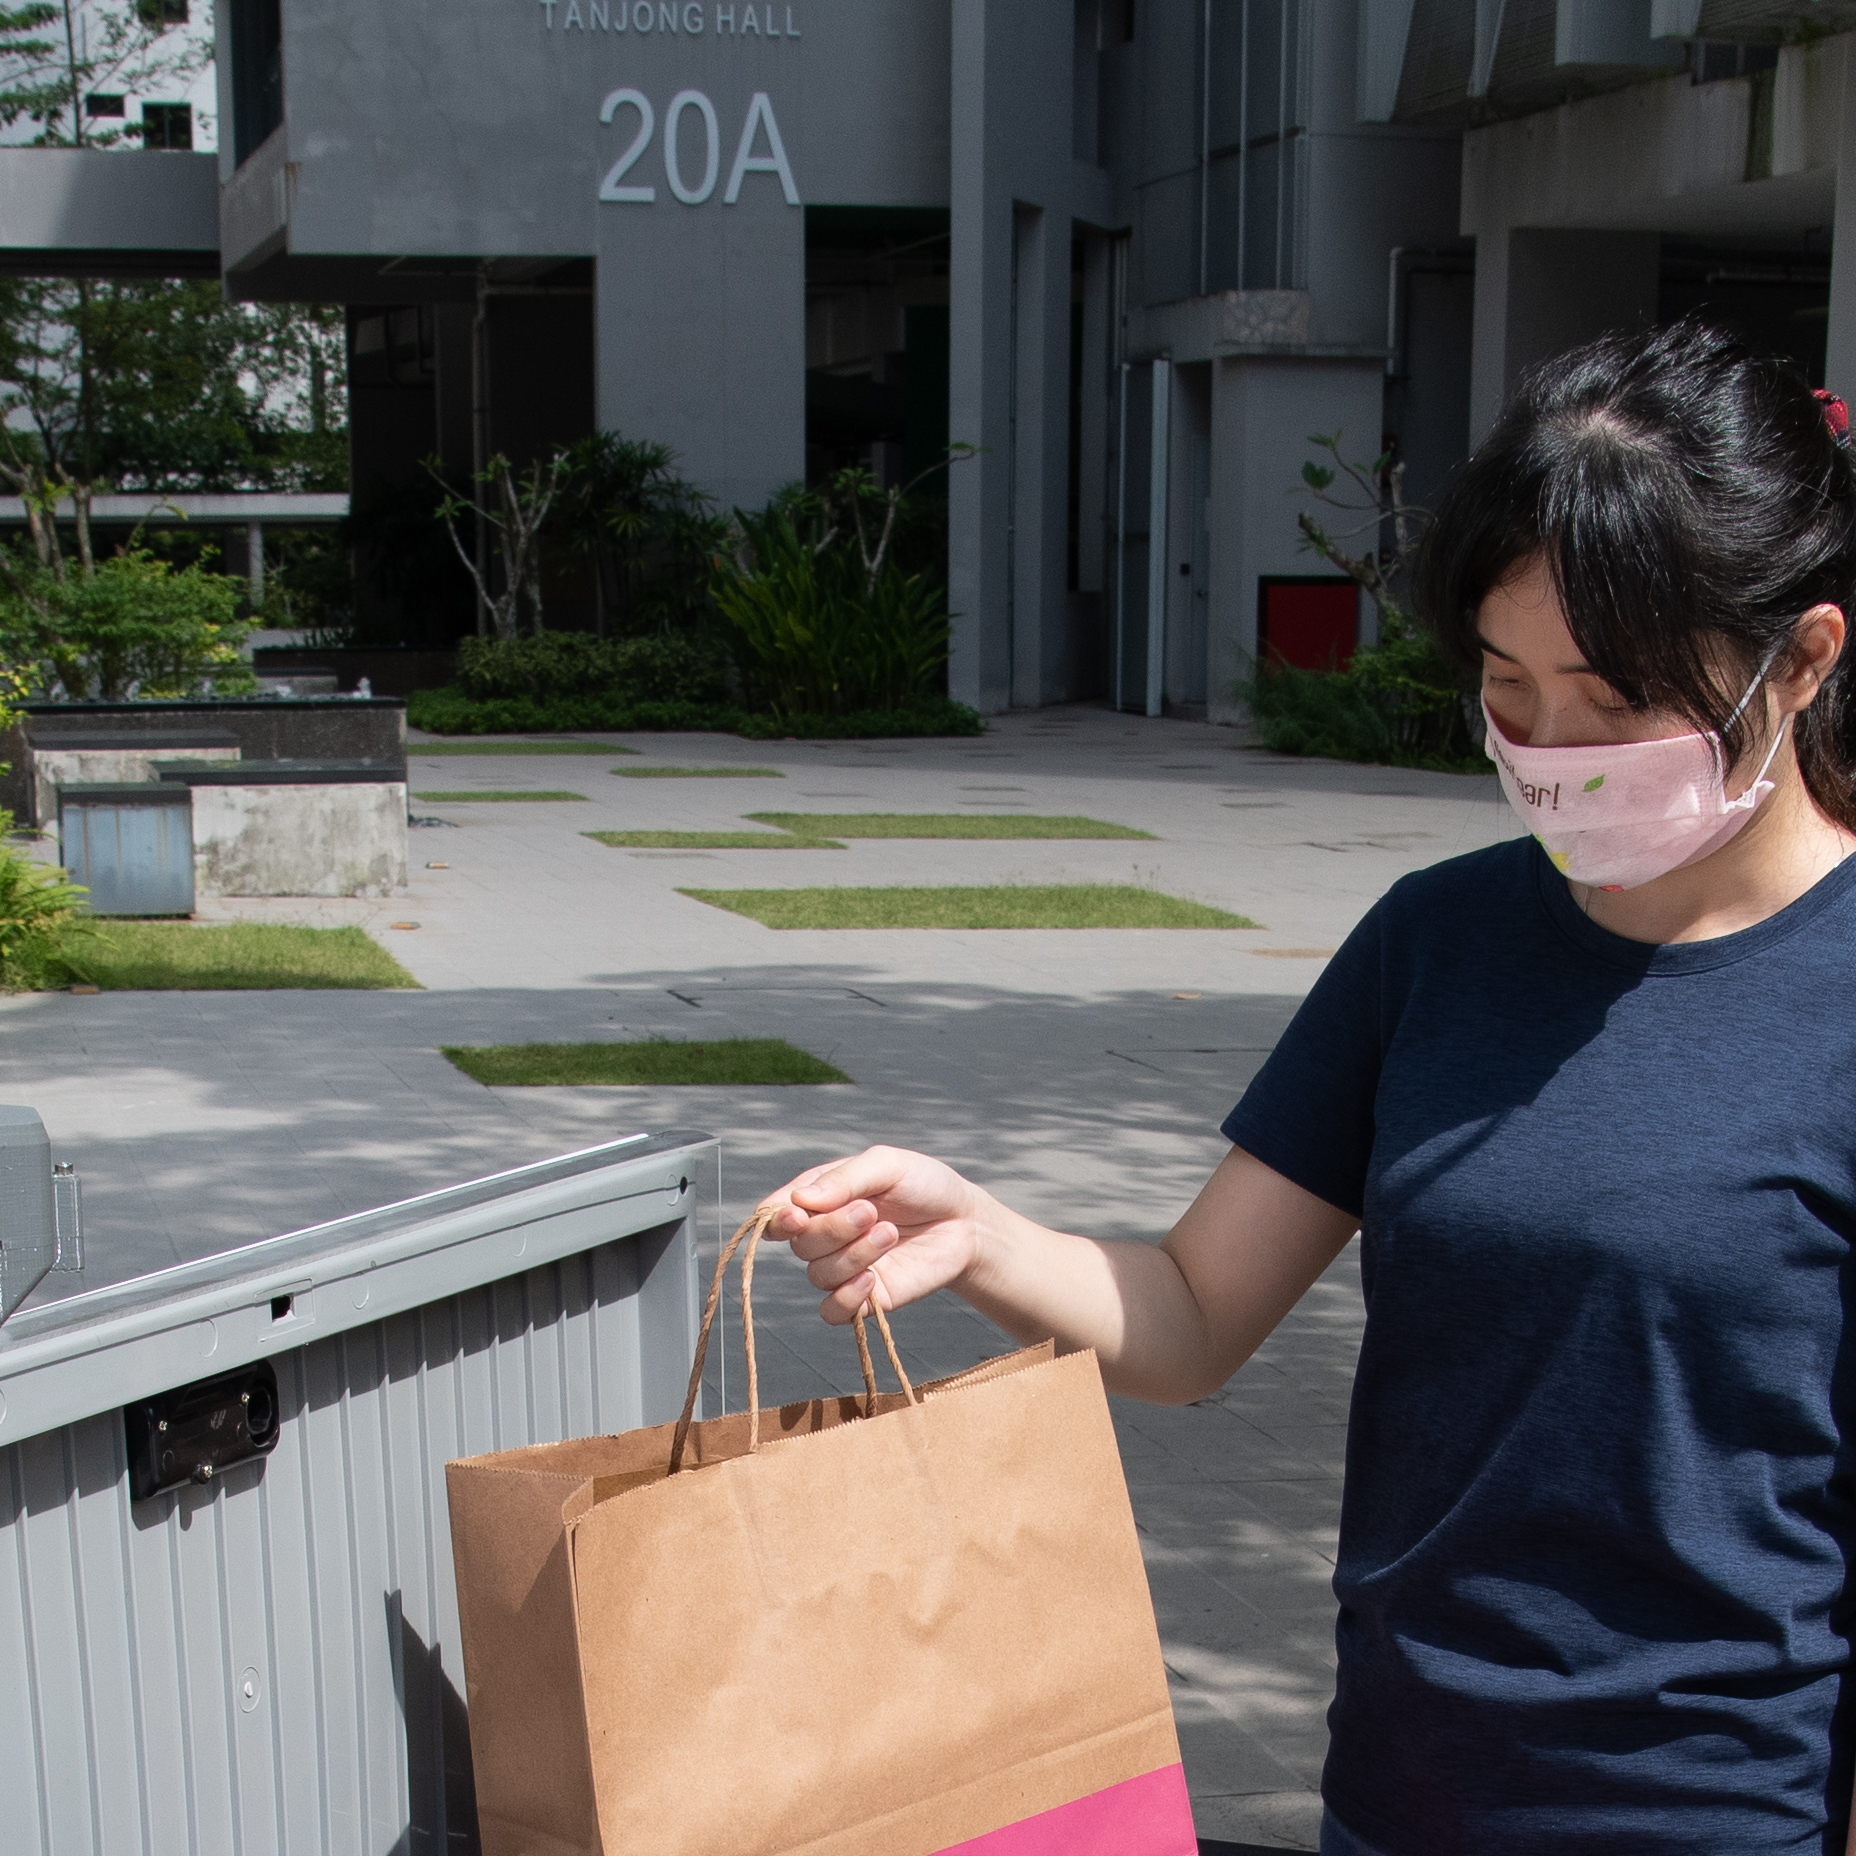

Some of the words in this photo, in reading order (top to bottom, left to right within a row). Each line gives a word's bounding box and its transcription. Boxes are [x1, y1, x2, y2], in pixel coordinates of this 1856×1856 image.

[540, 0, 704, 33] TANJONG
[716, 4, 801, 36] HALL
[599, 87, 800, 205] 20A
